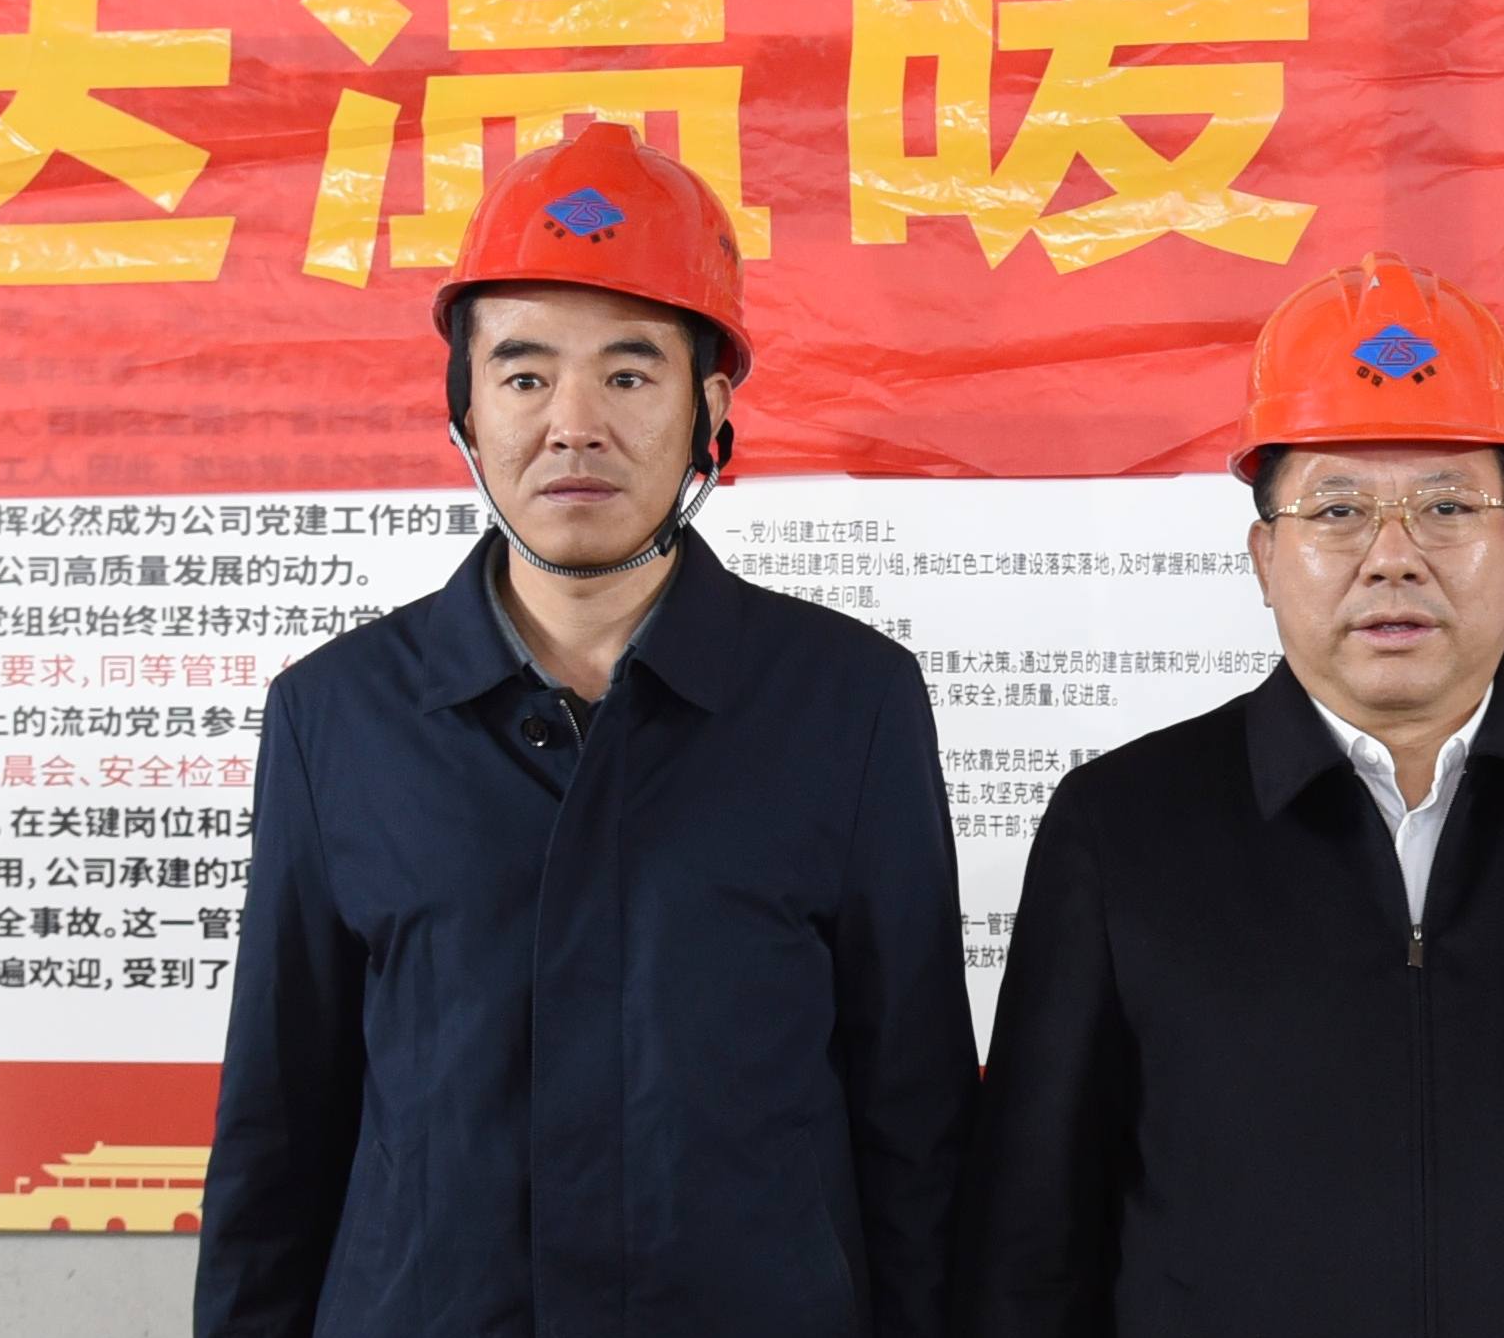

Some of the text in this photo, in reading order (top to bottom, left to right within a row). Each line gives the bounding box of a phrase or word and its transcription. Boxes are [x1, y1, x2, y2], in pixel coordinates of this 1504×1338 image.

[726, 520, 897, 543] 一、党小组建立在项目上
